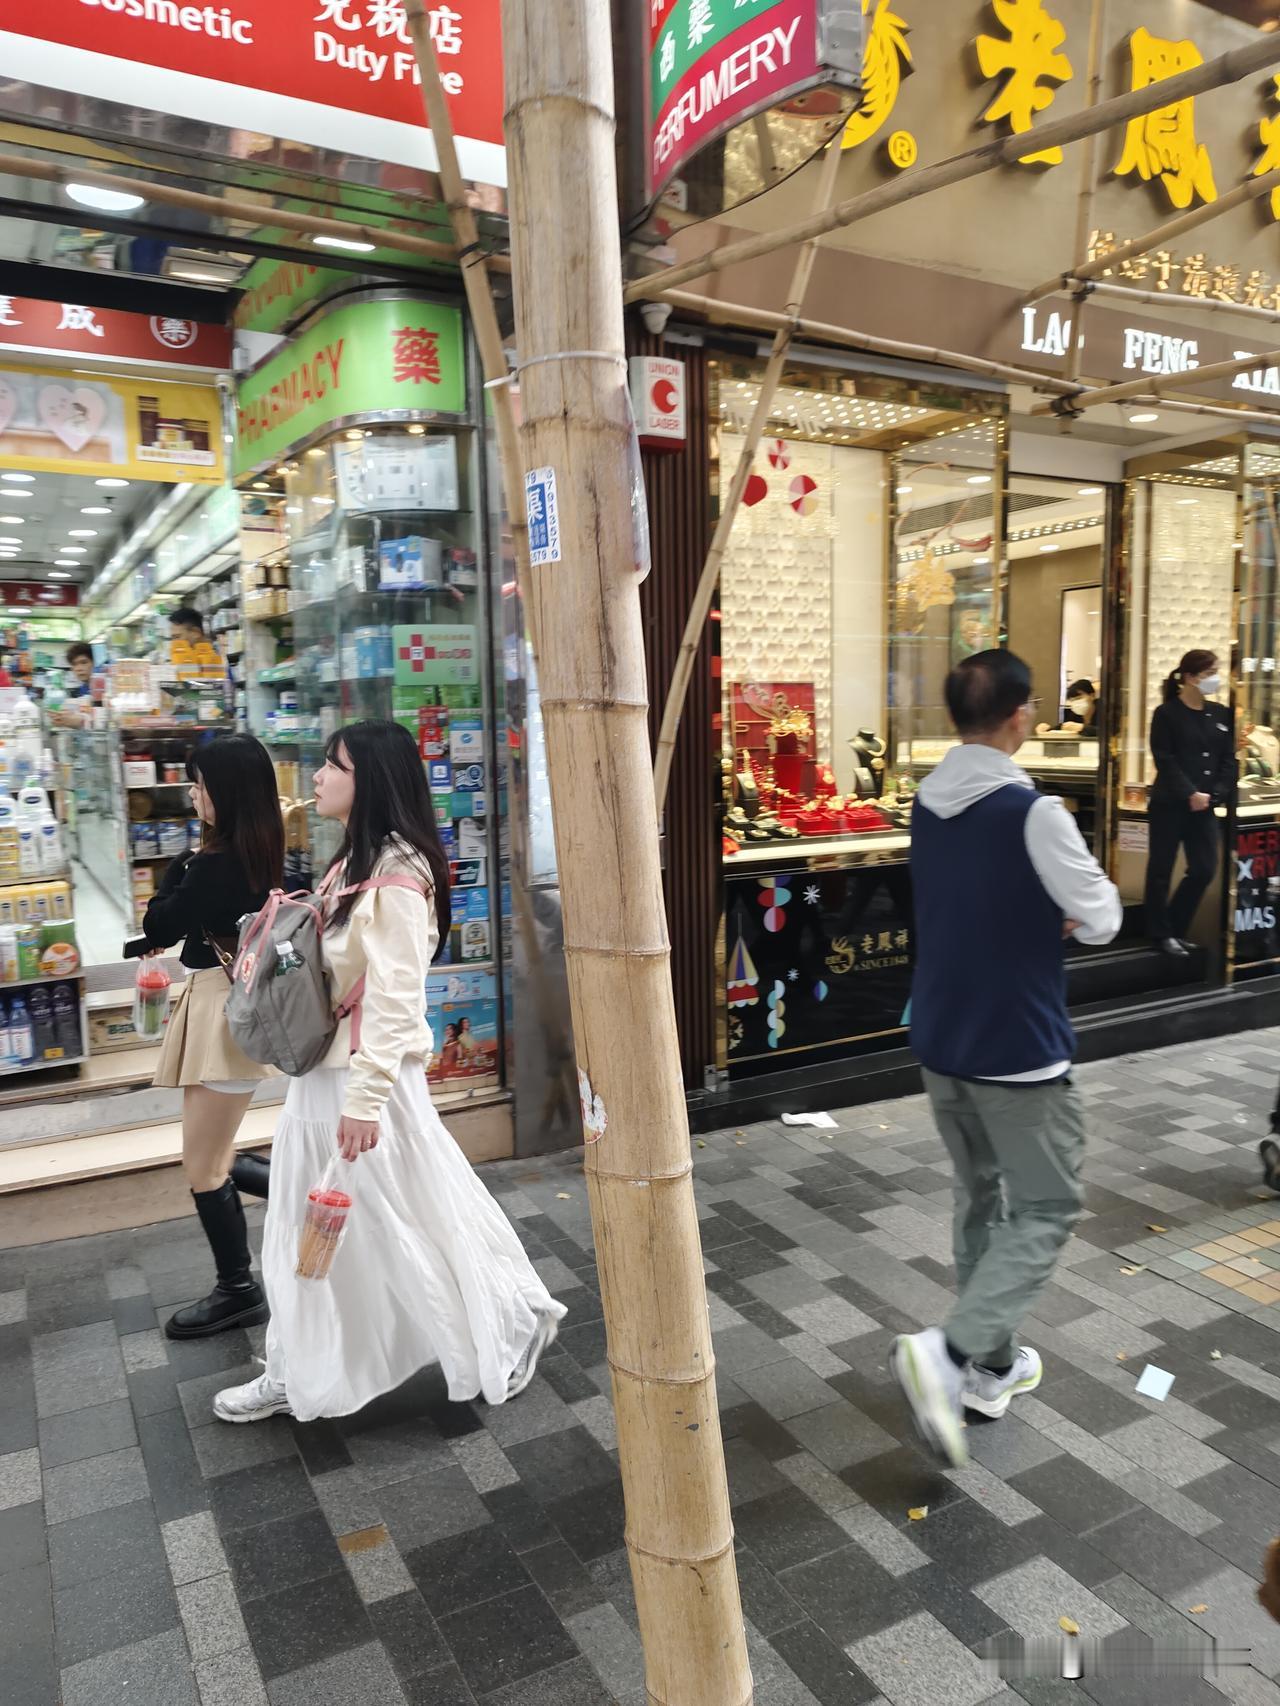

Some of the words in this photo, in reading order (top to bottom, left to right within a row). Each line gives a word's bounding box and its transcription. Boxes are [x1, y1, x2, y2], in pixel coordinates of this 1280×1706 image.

[314, 31, 388, 82] Duty
[660, 0, 760, 83] 西藥
[653, 16, 802, 176] PERFUMERY
[391, 325, 442, 385] 藥
[1123, 327, 1200, 375] FENG
[238, 337, 345, 448] PHARMACY
[1234, 905, 1276, 933] MAS
